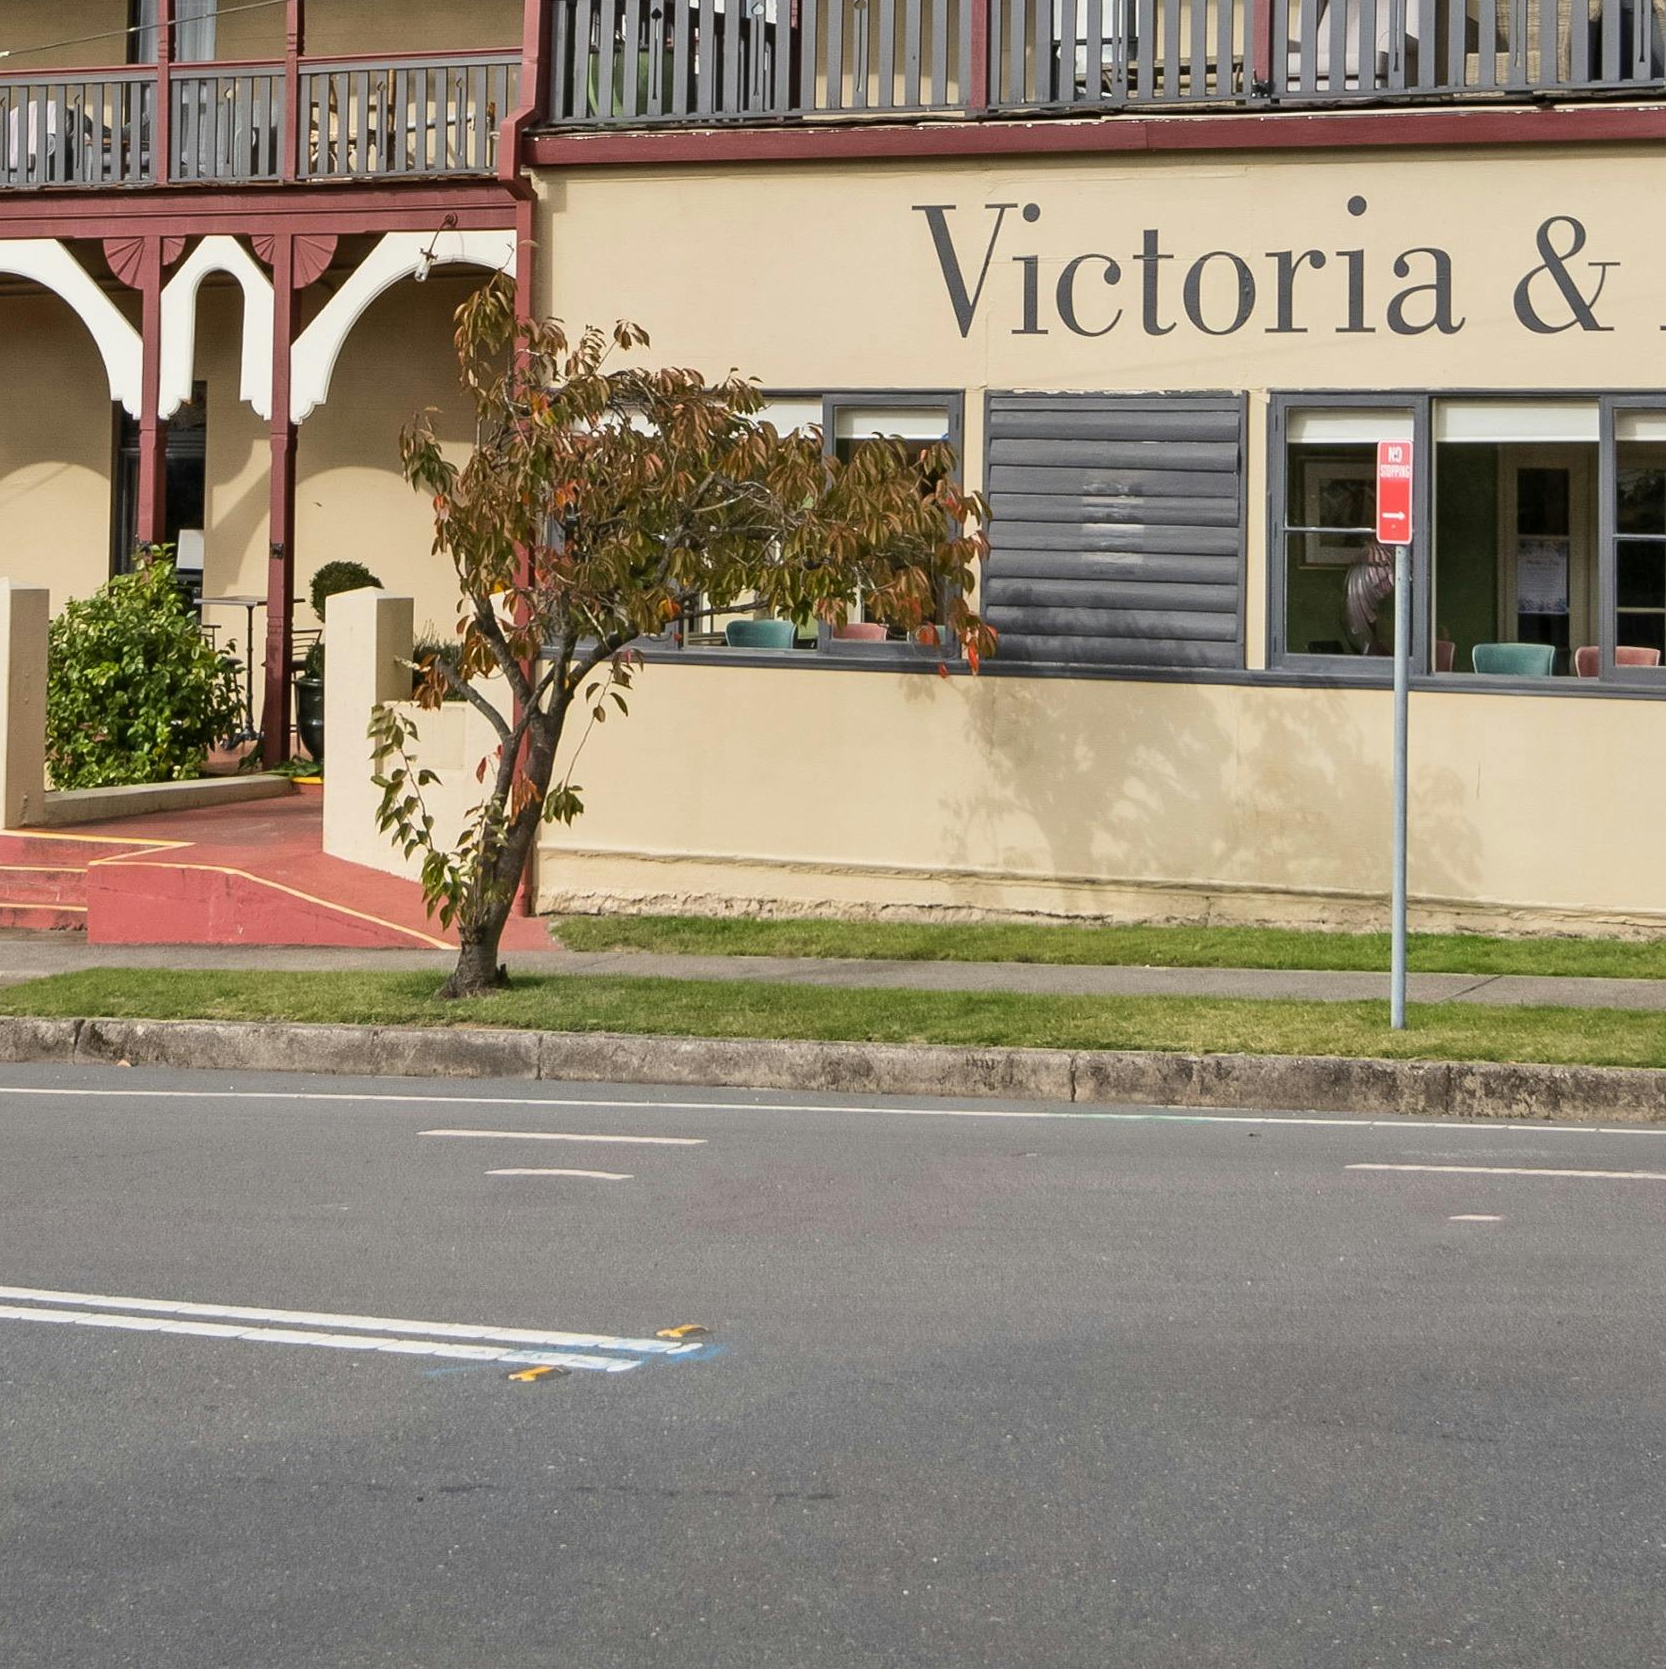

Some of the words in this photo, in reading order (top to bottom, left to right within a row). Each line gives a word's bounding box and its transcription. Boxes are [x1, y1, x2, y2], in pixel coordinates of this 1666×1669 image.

[911, 194, 1467, 339] Victoria
[1513, 215, 1621, 334] &
[1388, 446, 1403, 463] NO
[1380, 464, 1411, 479] STOPPING
